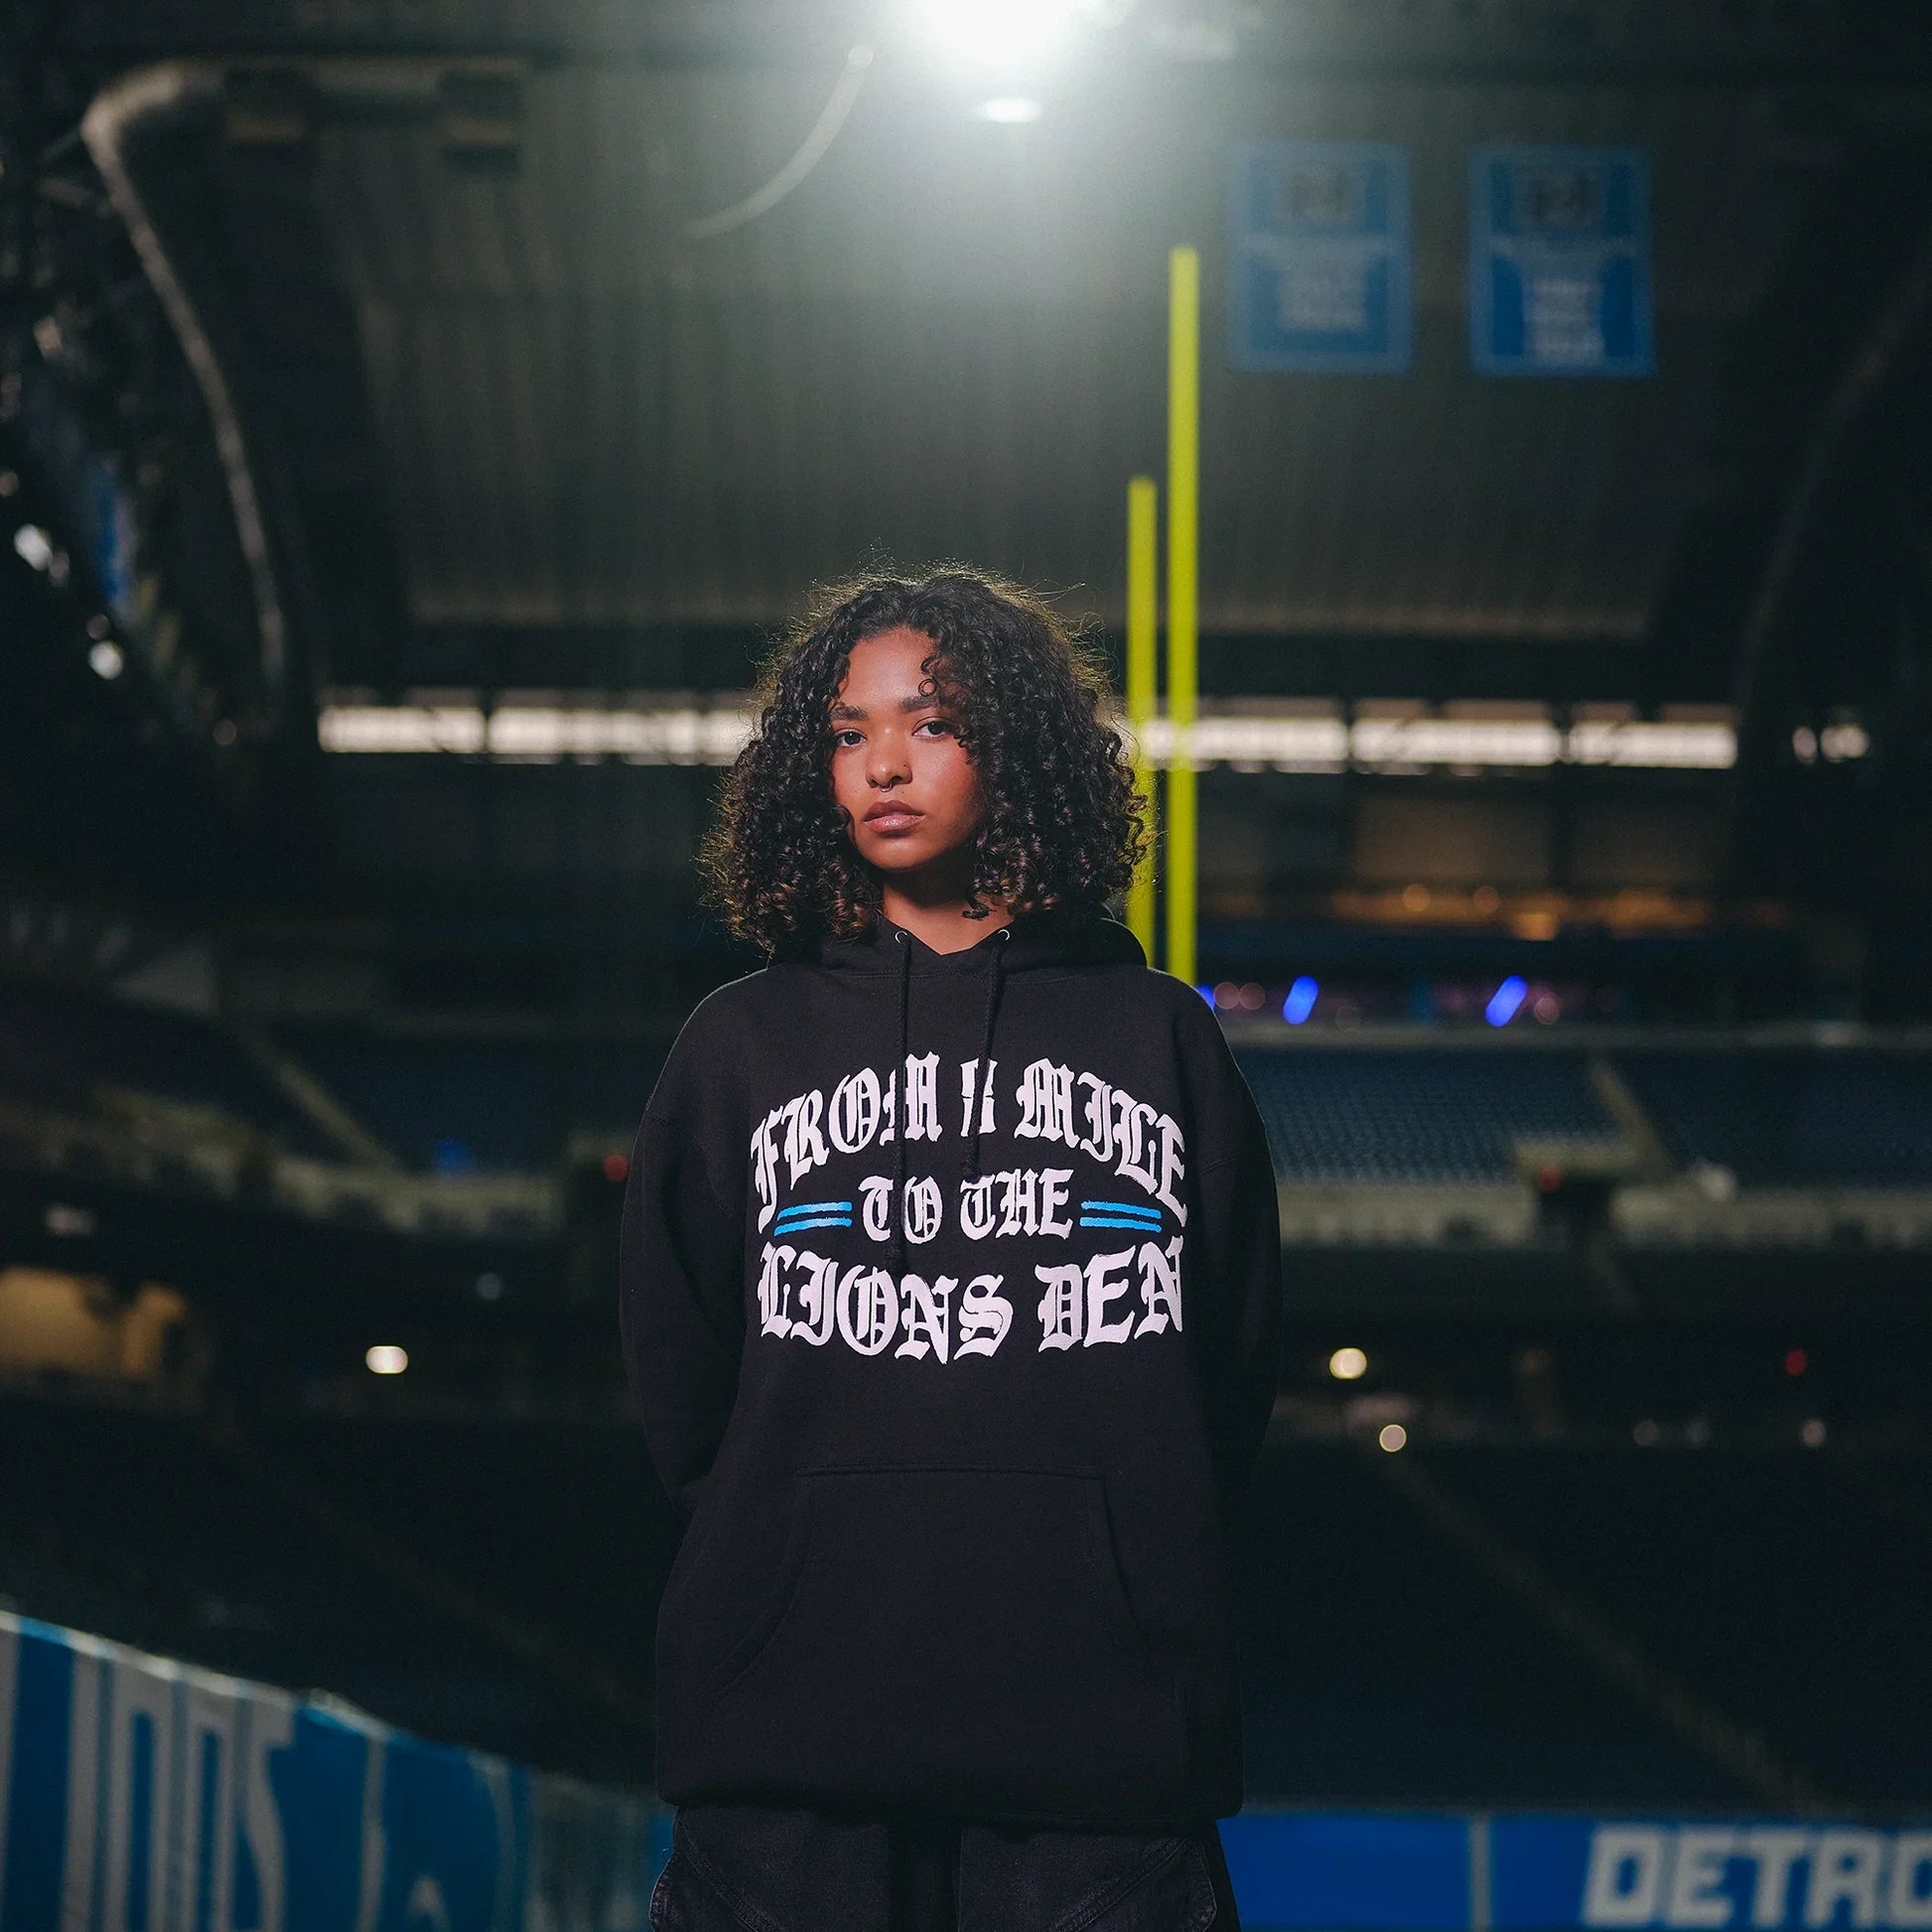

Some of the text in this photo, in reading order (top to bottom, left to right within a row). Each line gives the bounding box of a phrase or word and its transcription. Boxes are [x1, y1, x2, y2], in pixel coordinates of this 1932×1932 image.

[751, 1050, 943, 1234] FROM
[1013, 1057, 1188, 1228] MILE
[858, 1167, 1074, 1245] TO THE
[757, 1234, 1184, 1365] LIONS DEN
